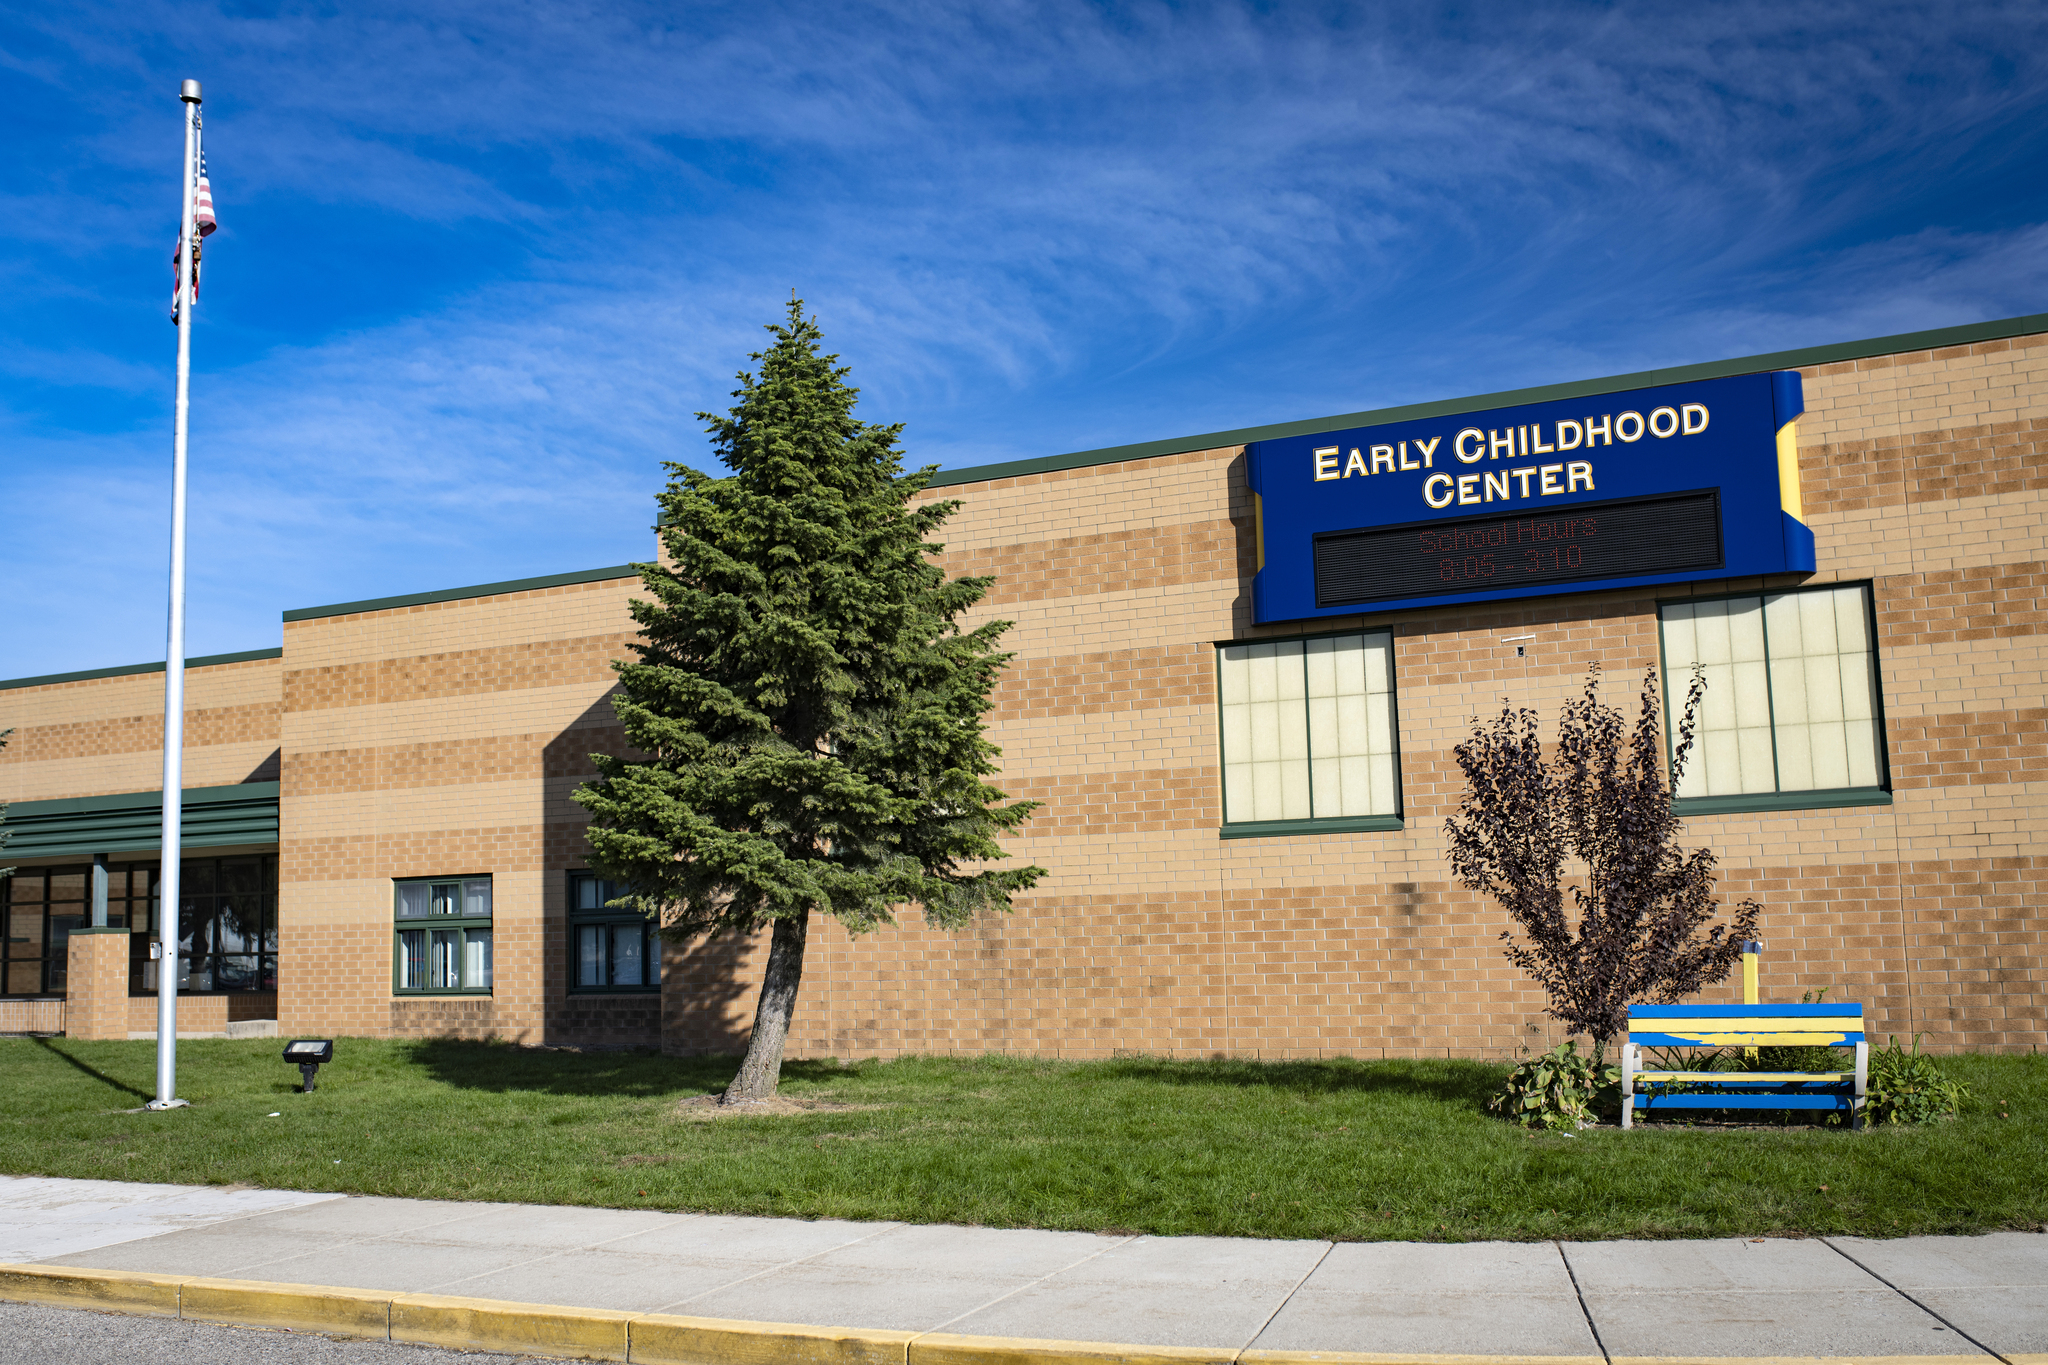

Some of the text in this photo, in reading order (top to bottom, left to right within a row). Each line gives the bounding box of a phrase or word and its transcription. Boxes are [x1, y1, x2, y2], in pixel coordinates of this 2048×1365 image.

[1312, 402, 1710, 482] EARLY CHILDHOOD
[1422, 459, 1596, 509] CENTER
[1419, 519, 1597, 553] School Hours
[1439, 553, 1495, 581] 8:05
[1524, 545, 1582, 572] 3:10
